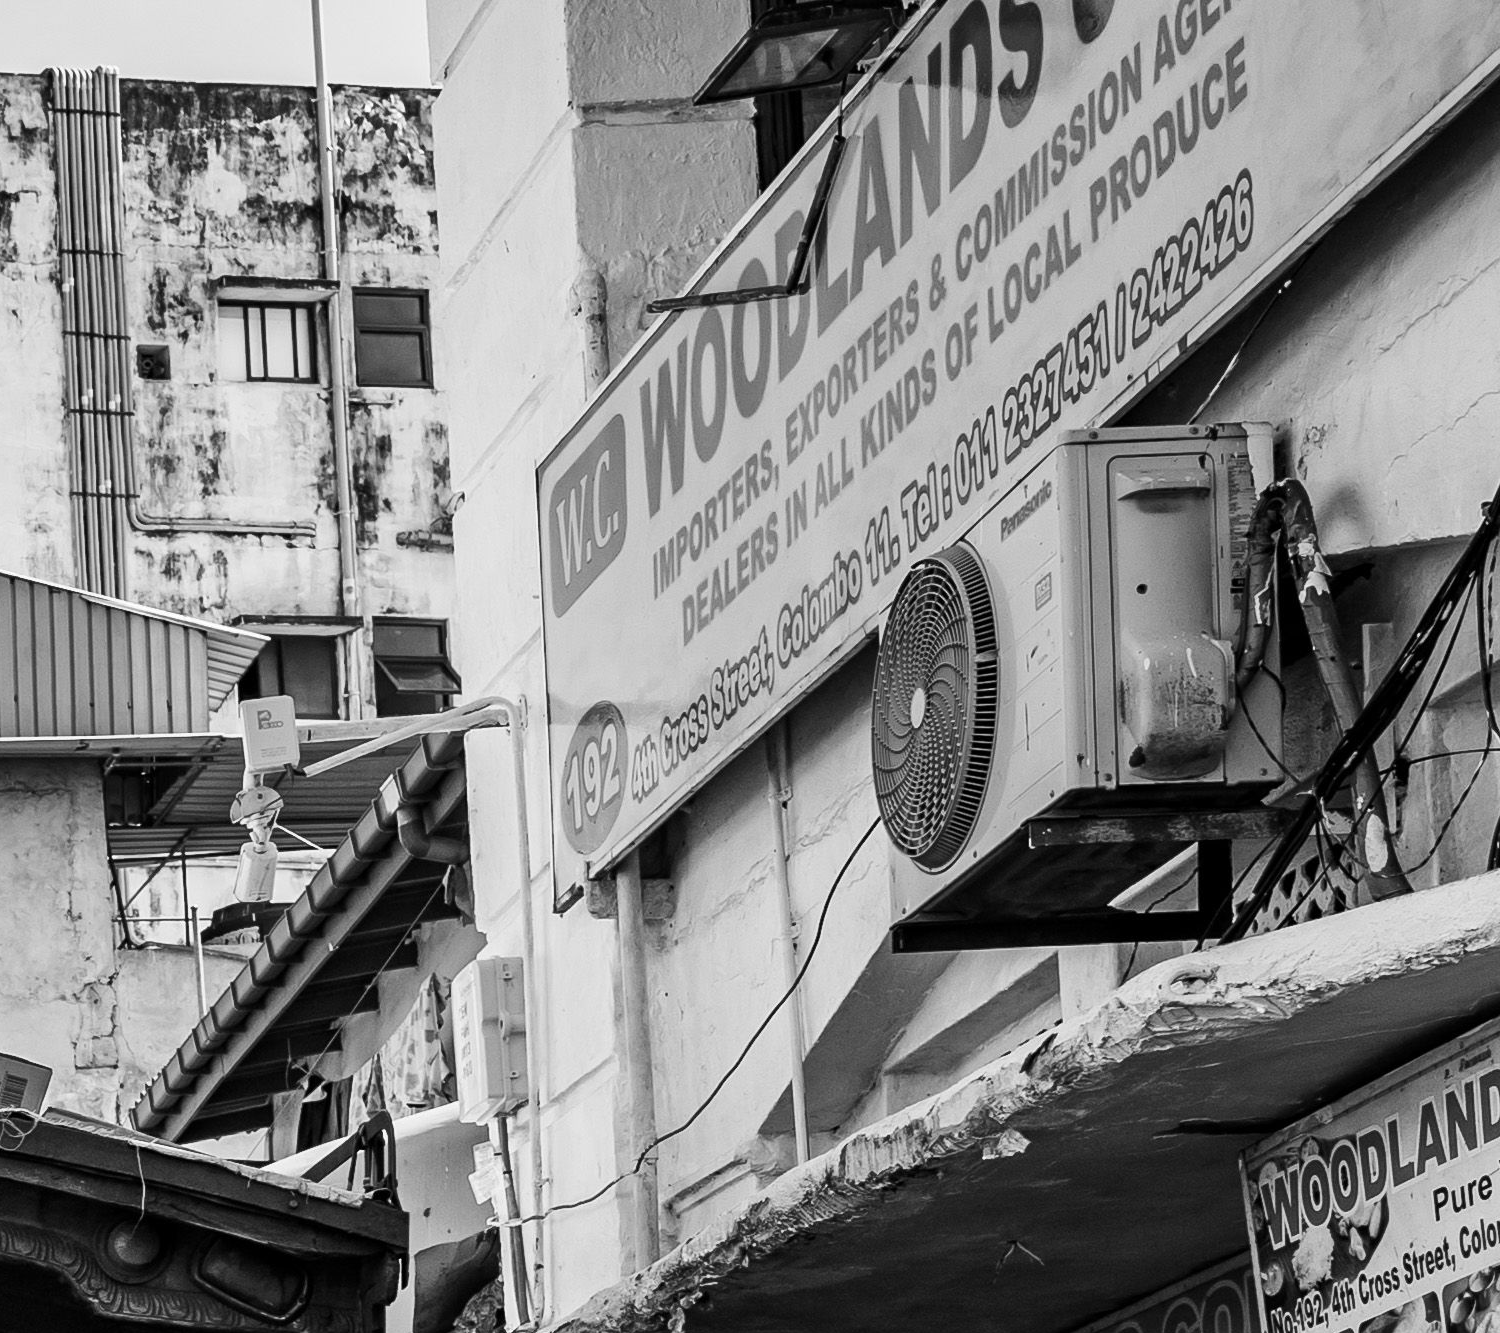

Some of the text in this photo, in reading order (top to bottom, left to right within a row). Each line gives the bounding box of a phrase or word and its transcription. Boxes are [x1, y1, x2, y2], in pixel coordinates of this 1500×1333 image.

[652, 438, 779, 600] IMPORTERS,
[785, 279, 920, 464] EXPORTERS
[929, 253, 947, 313] &
[955, 41, 1142, 282] COMMISSION
[681, 37, 1249, 646] DEALERS IN ALL KINDS OF LOCAL PRODUCE
[555, 448, 621, 588] W.C.
[563, 718, 622, 833] 192
[631, 733, 659, 804] 4th
[660, 694, 709, 775] Cross
[710, 626, 774, 731] Street,
[777, 550, 862, 671] Colombo
[865, 506, 900, 585] 11.
[954, 405, 998, 506] 011
[1003, 300, 1110, 466] 2327451
[1128, 167, 1254, 351] 2422426
[1000, 479, 1052, 541] Panasonic
[1432, 1174, 1493, 1221] Pure
[1331, 1279, 1356, 1315] 4th
[1358, 1267, 1400, 1304] Cross
[1402, 1237, 1456, 1285] Street,
